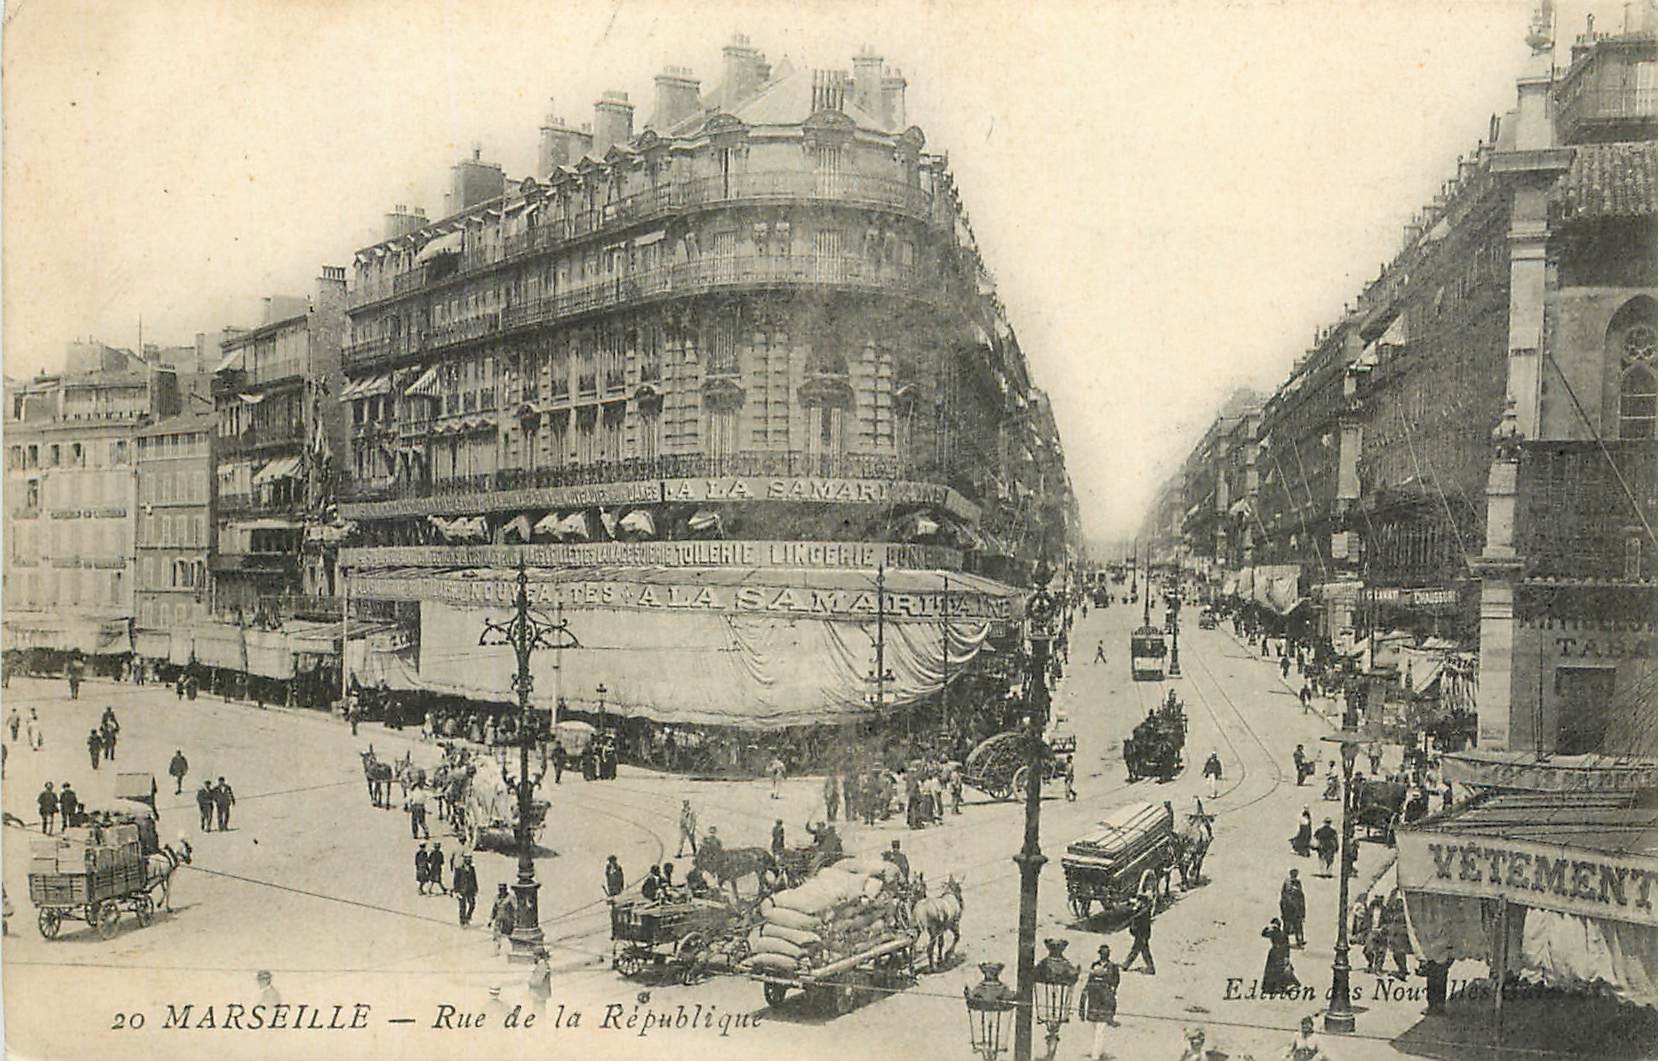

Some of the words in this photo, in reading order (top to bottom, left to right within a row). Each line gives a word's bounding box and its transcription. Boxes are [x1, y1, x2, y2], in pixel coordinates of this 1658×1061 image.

[677, 481, 694, 500] A
[706, 480, 753, 500] LA
[769, 543, 873, 566] LINGERIE
[637, 584, 661, 607] A
[667, 586, 726, 609] LA
[734, 587, 1010, 619] SAMARITAINE
